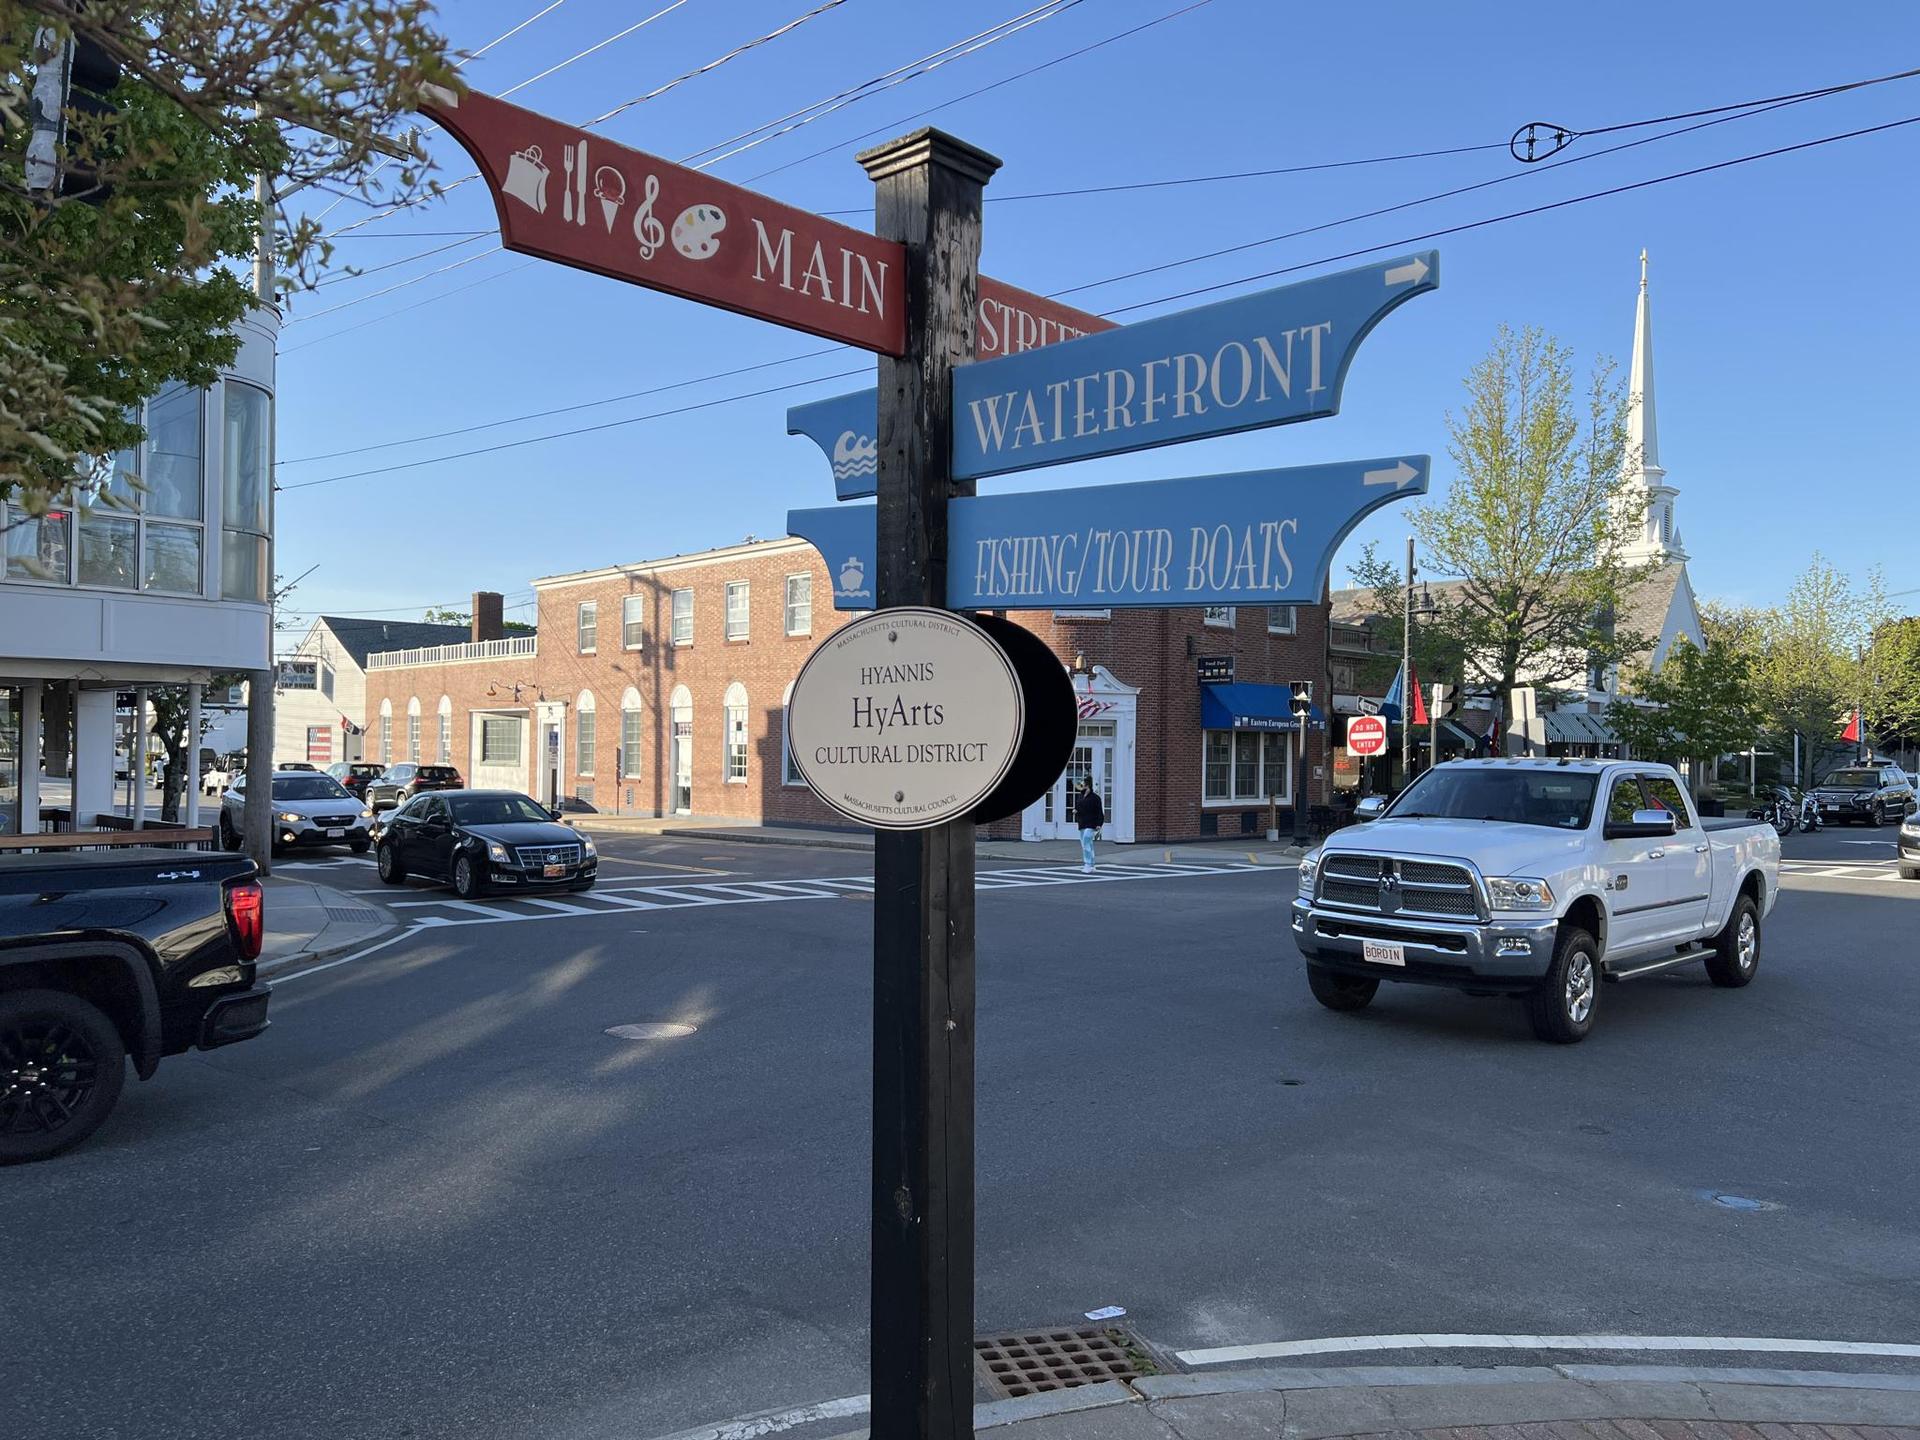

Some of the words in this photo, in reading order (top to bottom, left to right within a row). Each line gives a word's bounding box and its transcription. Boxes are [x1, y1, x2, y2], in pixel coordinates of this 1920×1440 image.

[751, 218, 889, 321] MAIN
[968, 320, 1332, 455] WATERFRONT
[973, 527, 1174, 598] FISHING/TOUR
[1185, 518, 1298, 593] BOATS
[836, 621, 890, 649] MASSACHUSETTS
[890, 619, 927, 629] CULTURAL
[928, 621, 961, 638] DISTRICT
[860, 662, 934, 685] HYANNIS
[852, 694, 944, 735] HyArts
[815, 746, 903, 765] CULTURAL
[907, 743, 988, 763] DISTRICT
[843, 793, 894, 815] MASSACHUSETTS
[894, 804, 927, 815] CULTURAL
[927, 794, 957, 811] COUNCIL
[1365, 946, 1401, 960] BORDIN
